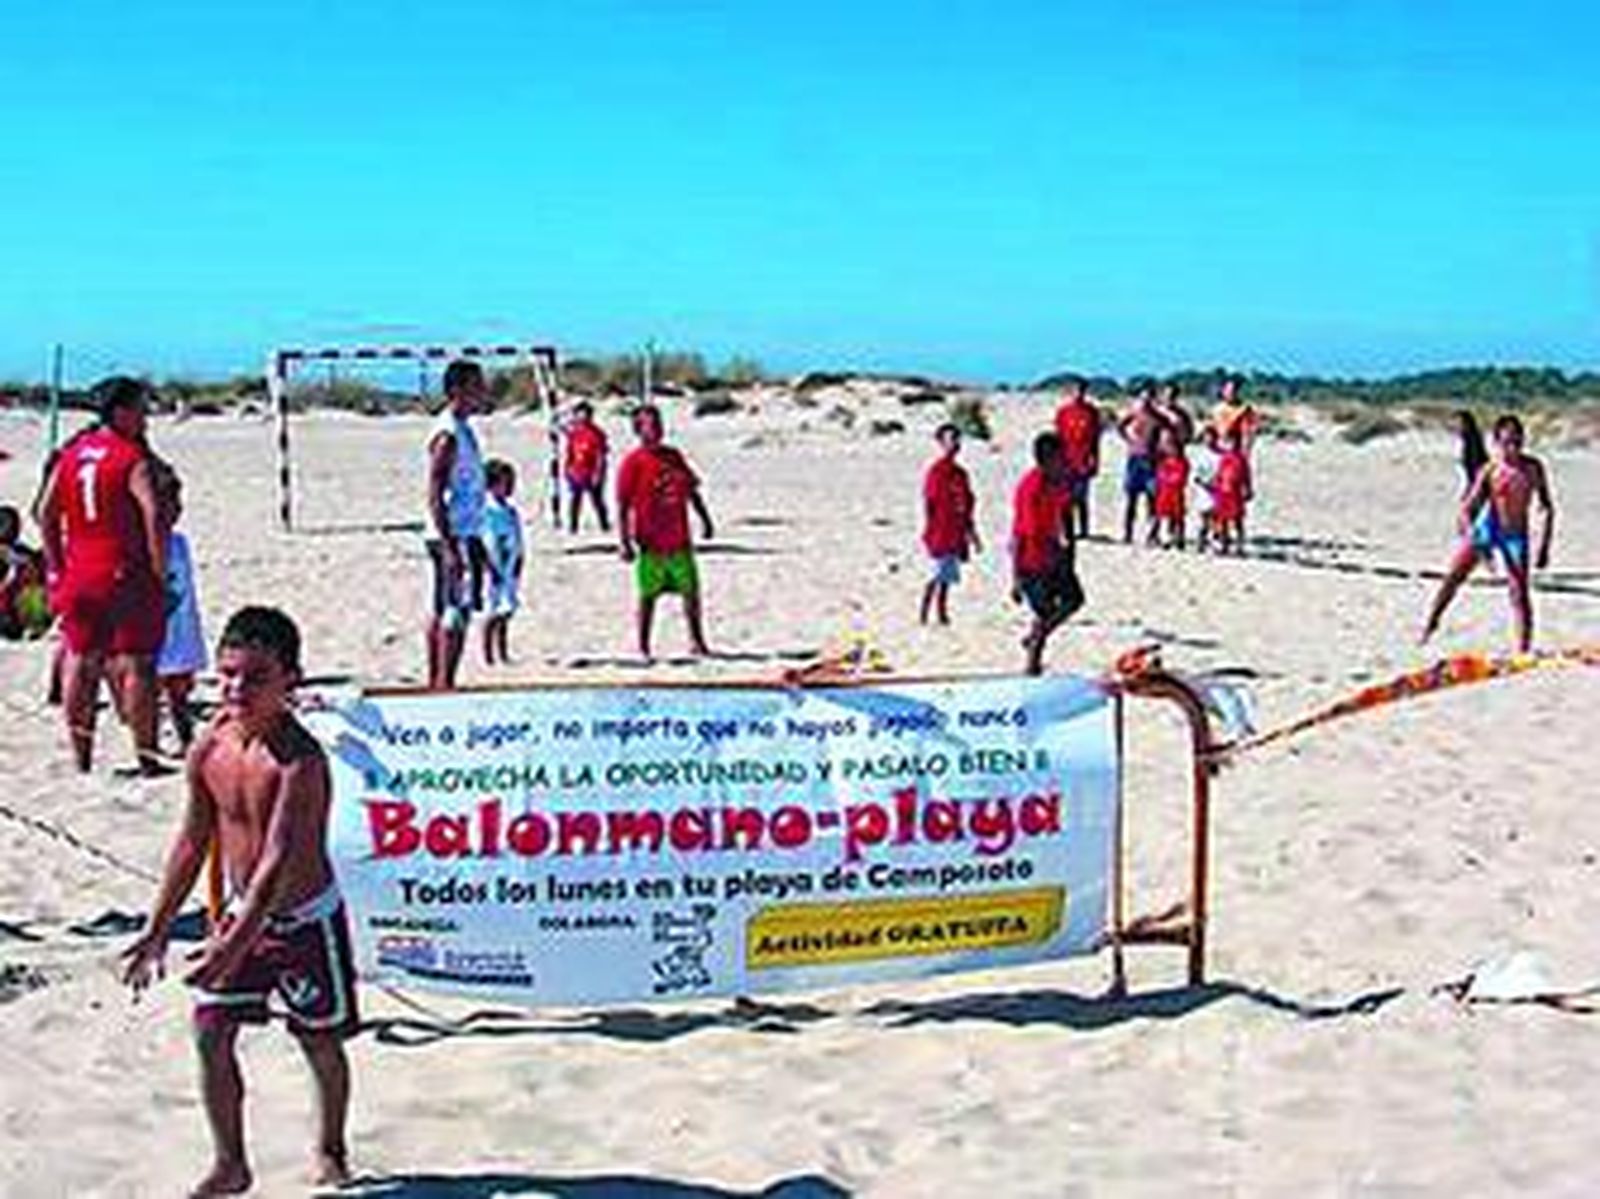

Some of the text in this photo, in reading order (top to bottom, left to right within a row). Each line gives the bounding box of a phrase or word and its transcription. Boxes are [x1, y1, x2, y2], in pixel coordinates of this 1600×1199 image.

[78, 463, 97, 520] 1
[553, 719, 583, 740] no
[592, 716, 690, 745] importa
[697, 716, 739, 743] que
[748, 719, 777, 738] no
[958, 708, 1029, 728] nunca
[387, 765, 550, 793] APROVECHA
[559, 767, 594, 786] LA
[605, 758, 807, 786] OPORTUNIDAD
[818, 762, 832, 782] Y
[400, 876, 488, 904] Todos
[496, 874, 536, 902] los
[549, 873, 628, 900] lunes
[634, 878, 675, 899] en
[681, 876, 716, 896] tu
[724, 868, 813, 899] playa
[821, 865, 859, 890] de
